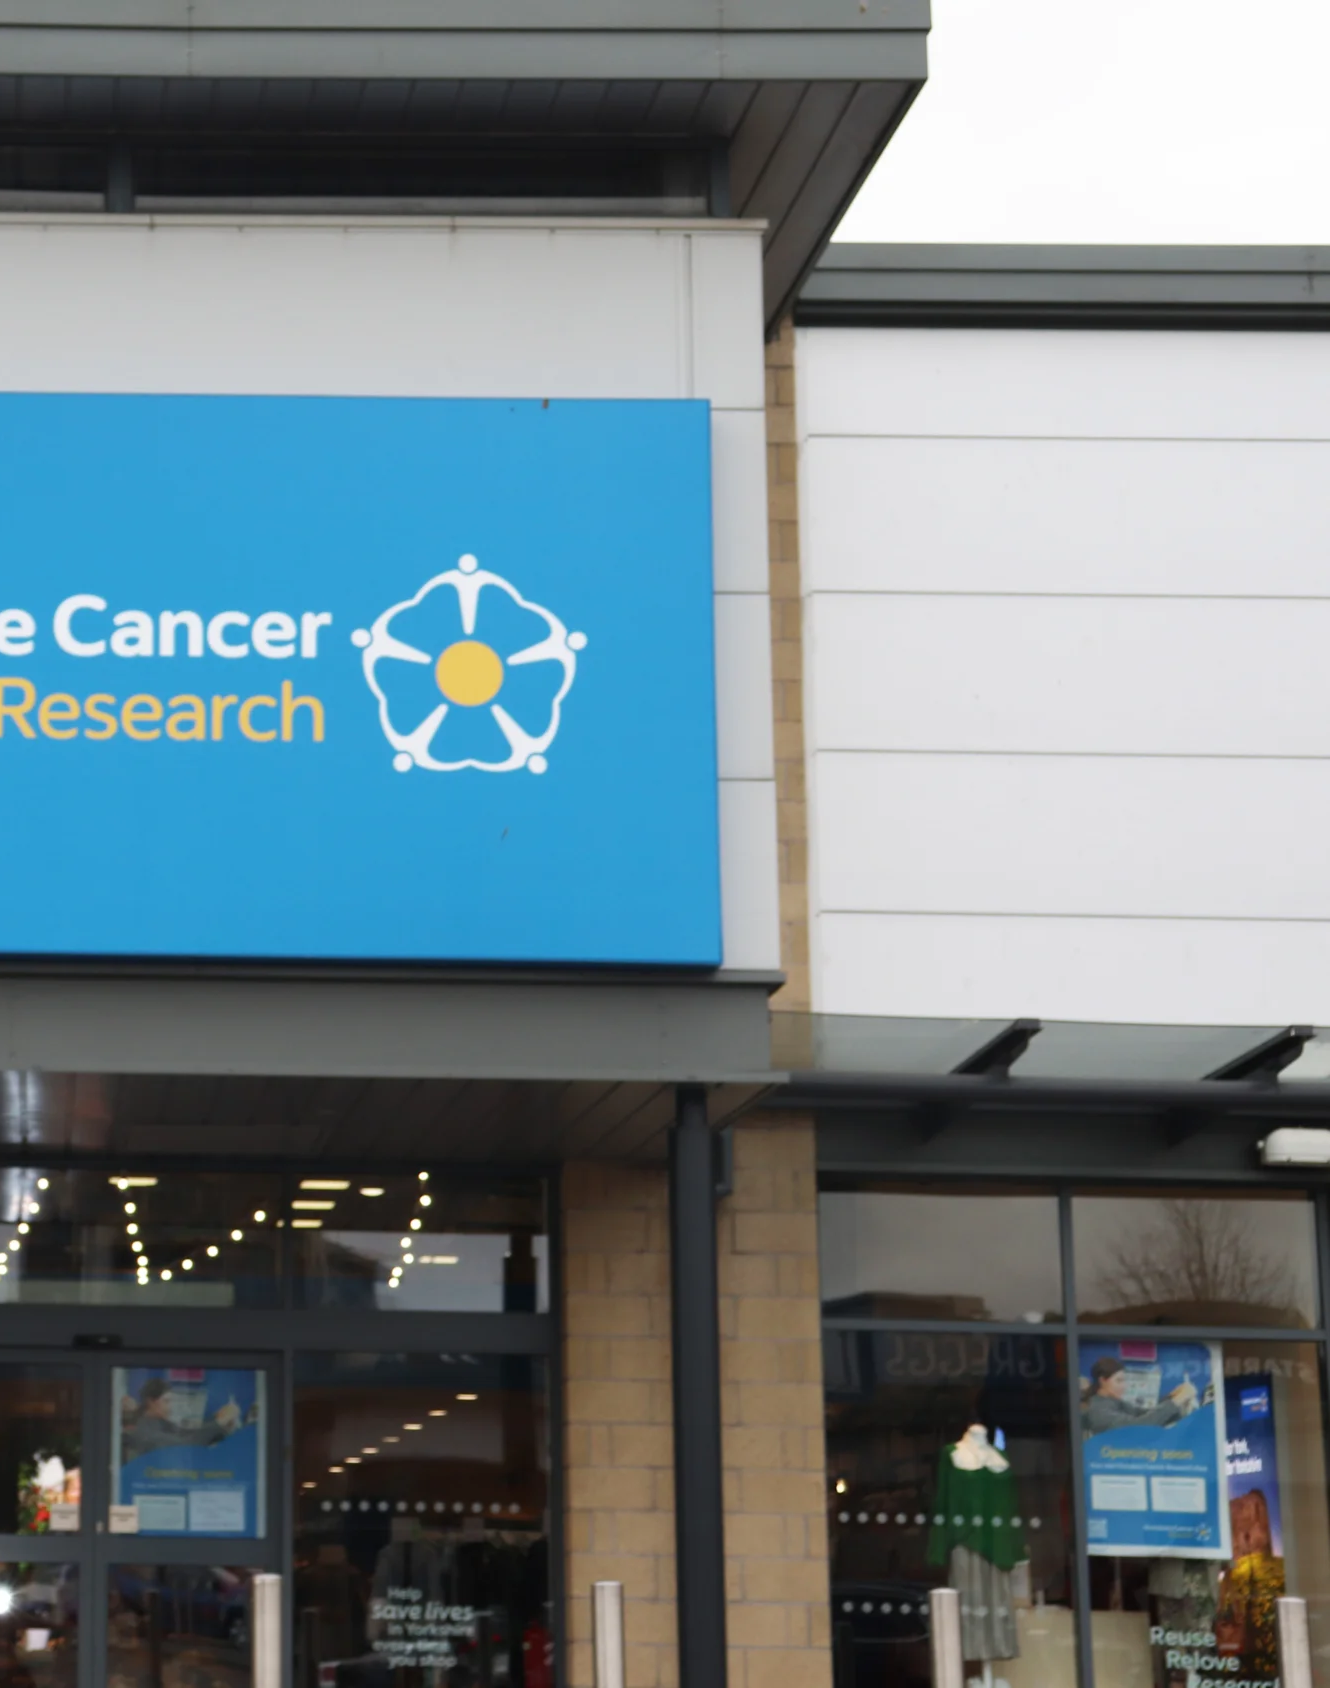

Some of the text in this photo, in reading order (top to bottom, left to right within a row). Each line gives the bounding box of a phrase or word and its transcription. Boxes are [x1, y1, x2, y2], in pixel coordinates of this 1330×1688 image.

[53, 594, 332, 658] Cancer
[424, 1601, 474, 1621] lives
[1150, 1626, 1217, 1647] Reuse
[1166, 1650, 1241, 1671] Relove
